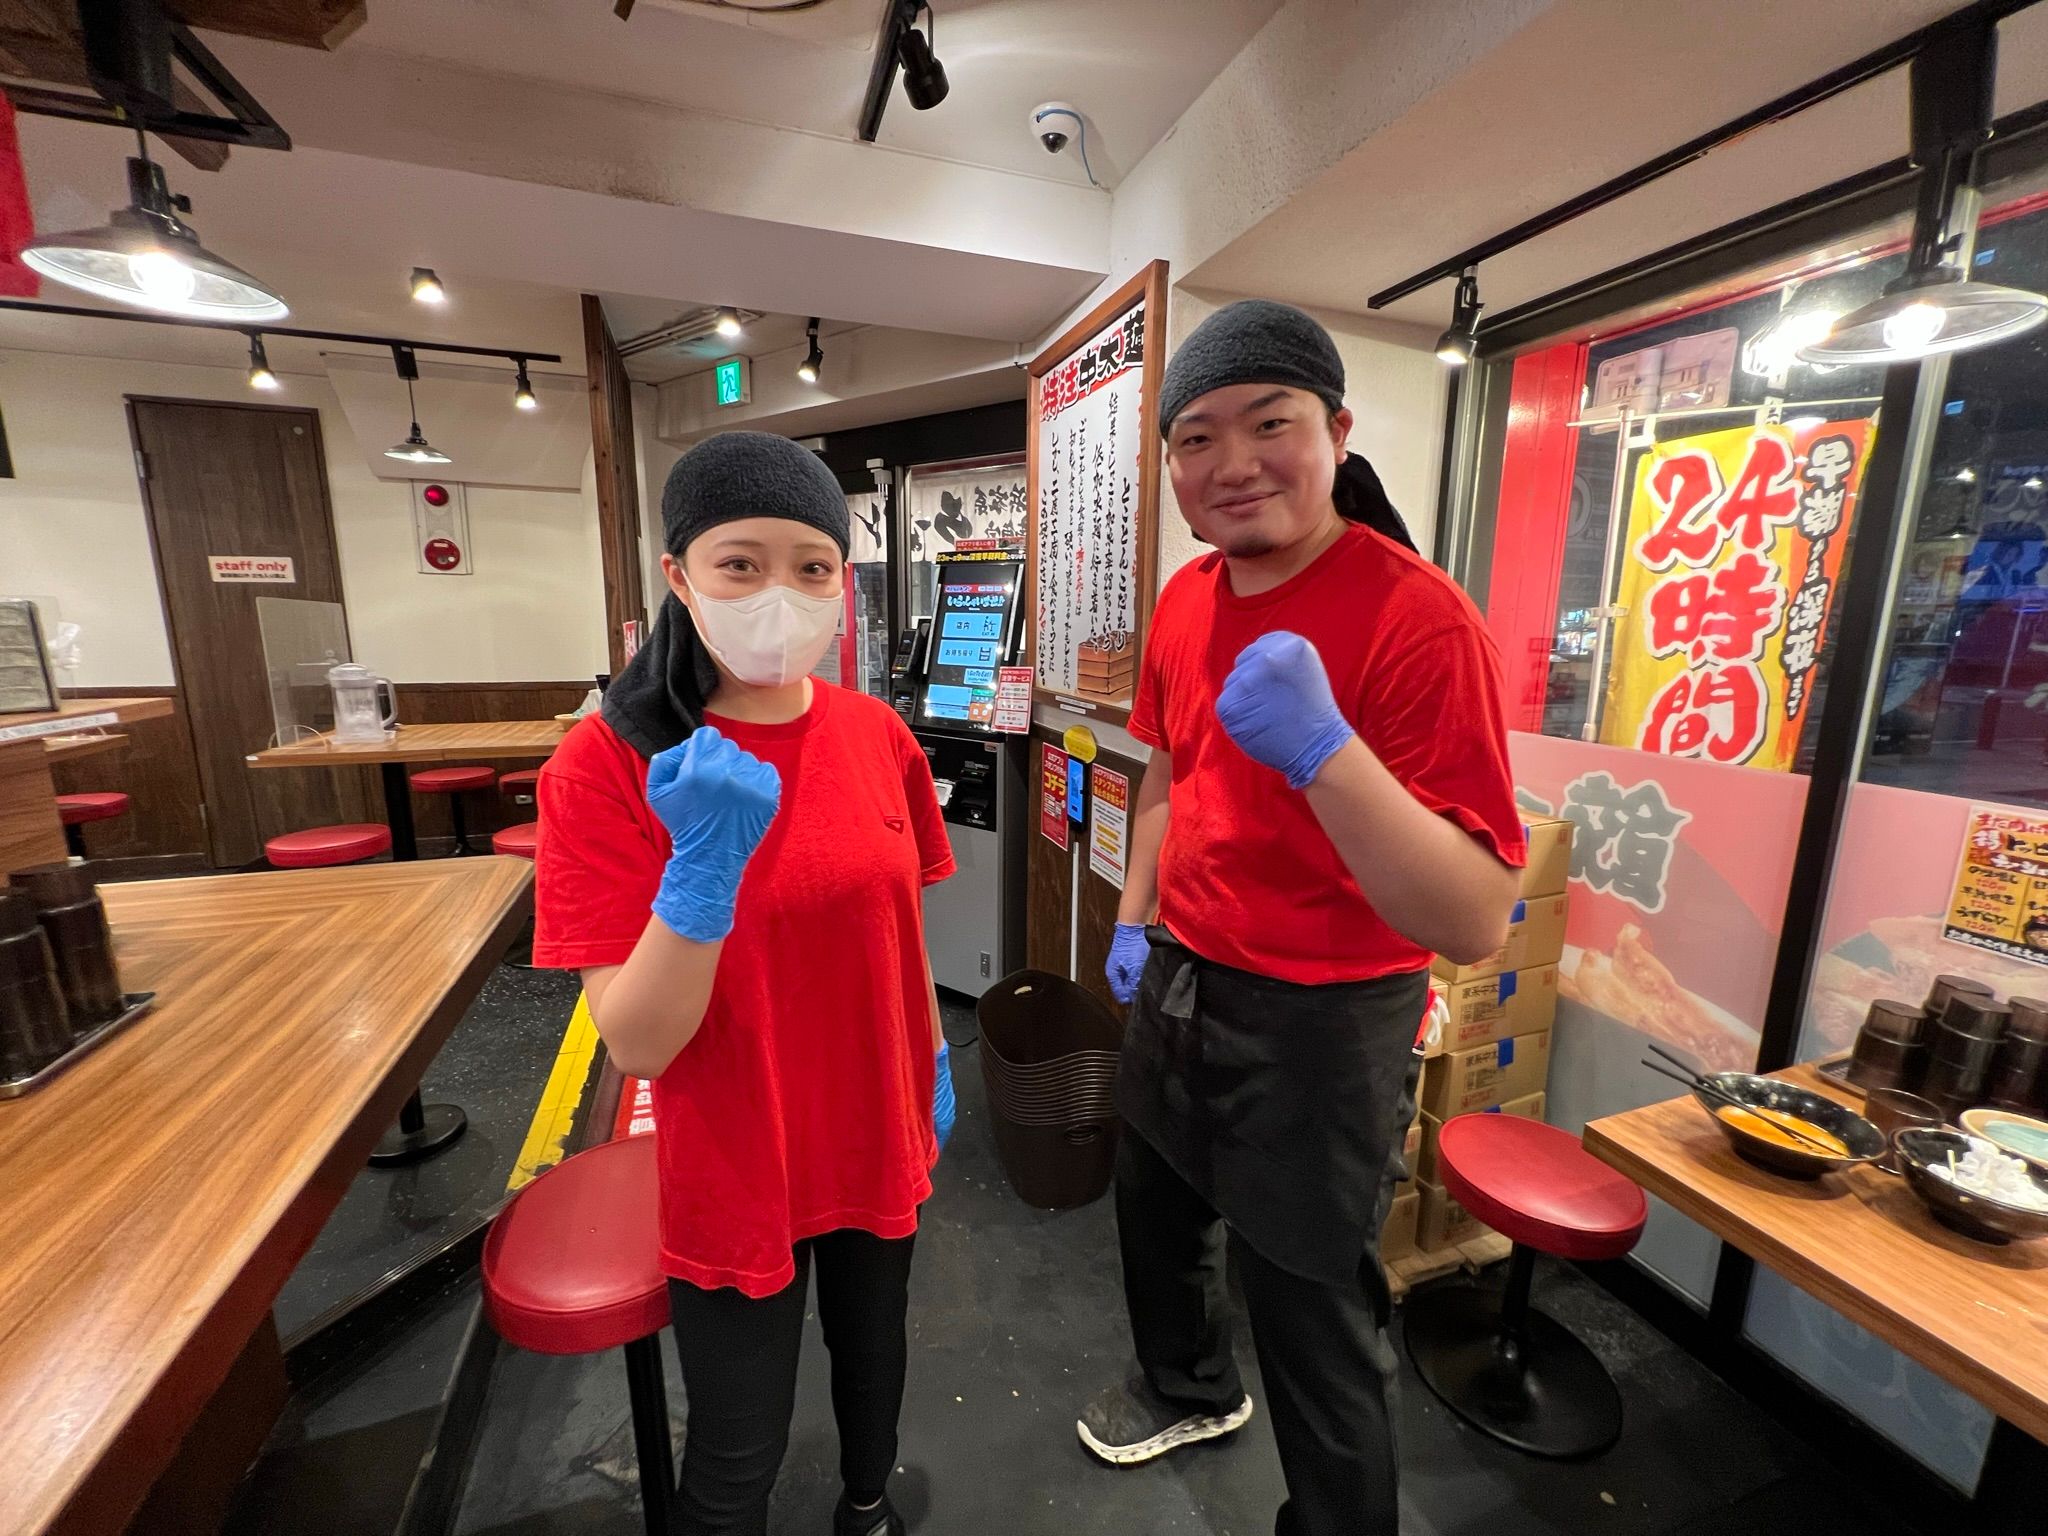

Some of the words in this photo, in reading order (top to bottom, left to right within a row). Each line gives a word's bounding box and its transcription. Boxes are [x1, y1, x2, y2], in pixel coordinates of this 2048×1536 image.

[215, 561, 252, 571] staff
[256, 561, 287, 572] only
[1640, 437, 1799, 762] 24時間
[1783, 438, 1852, 718] 早朝から深夜まで
